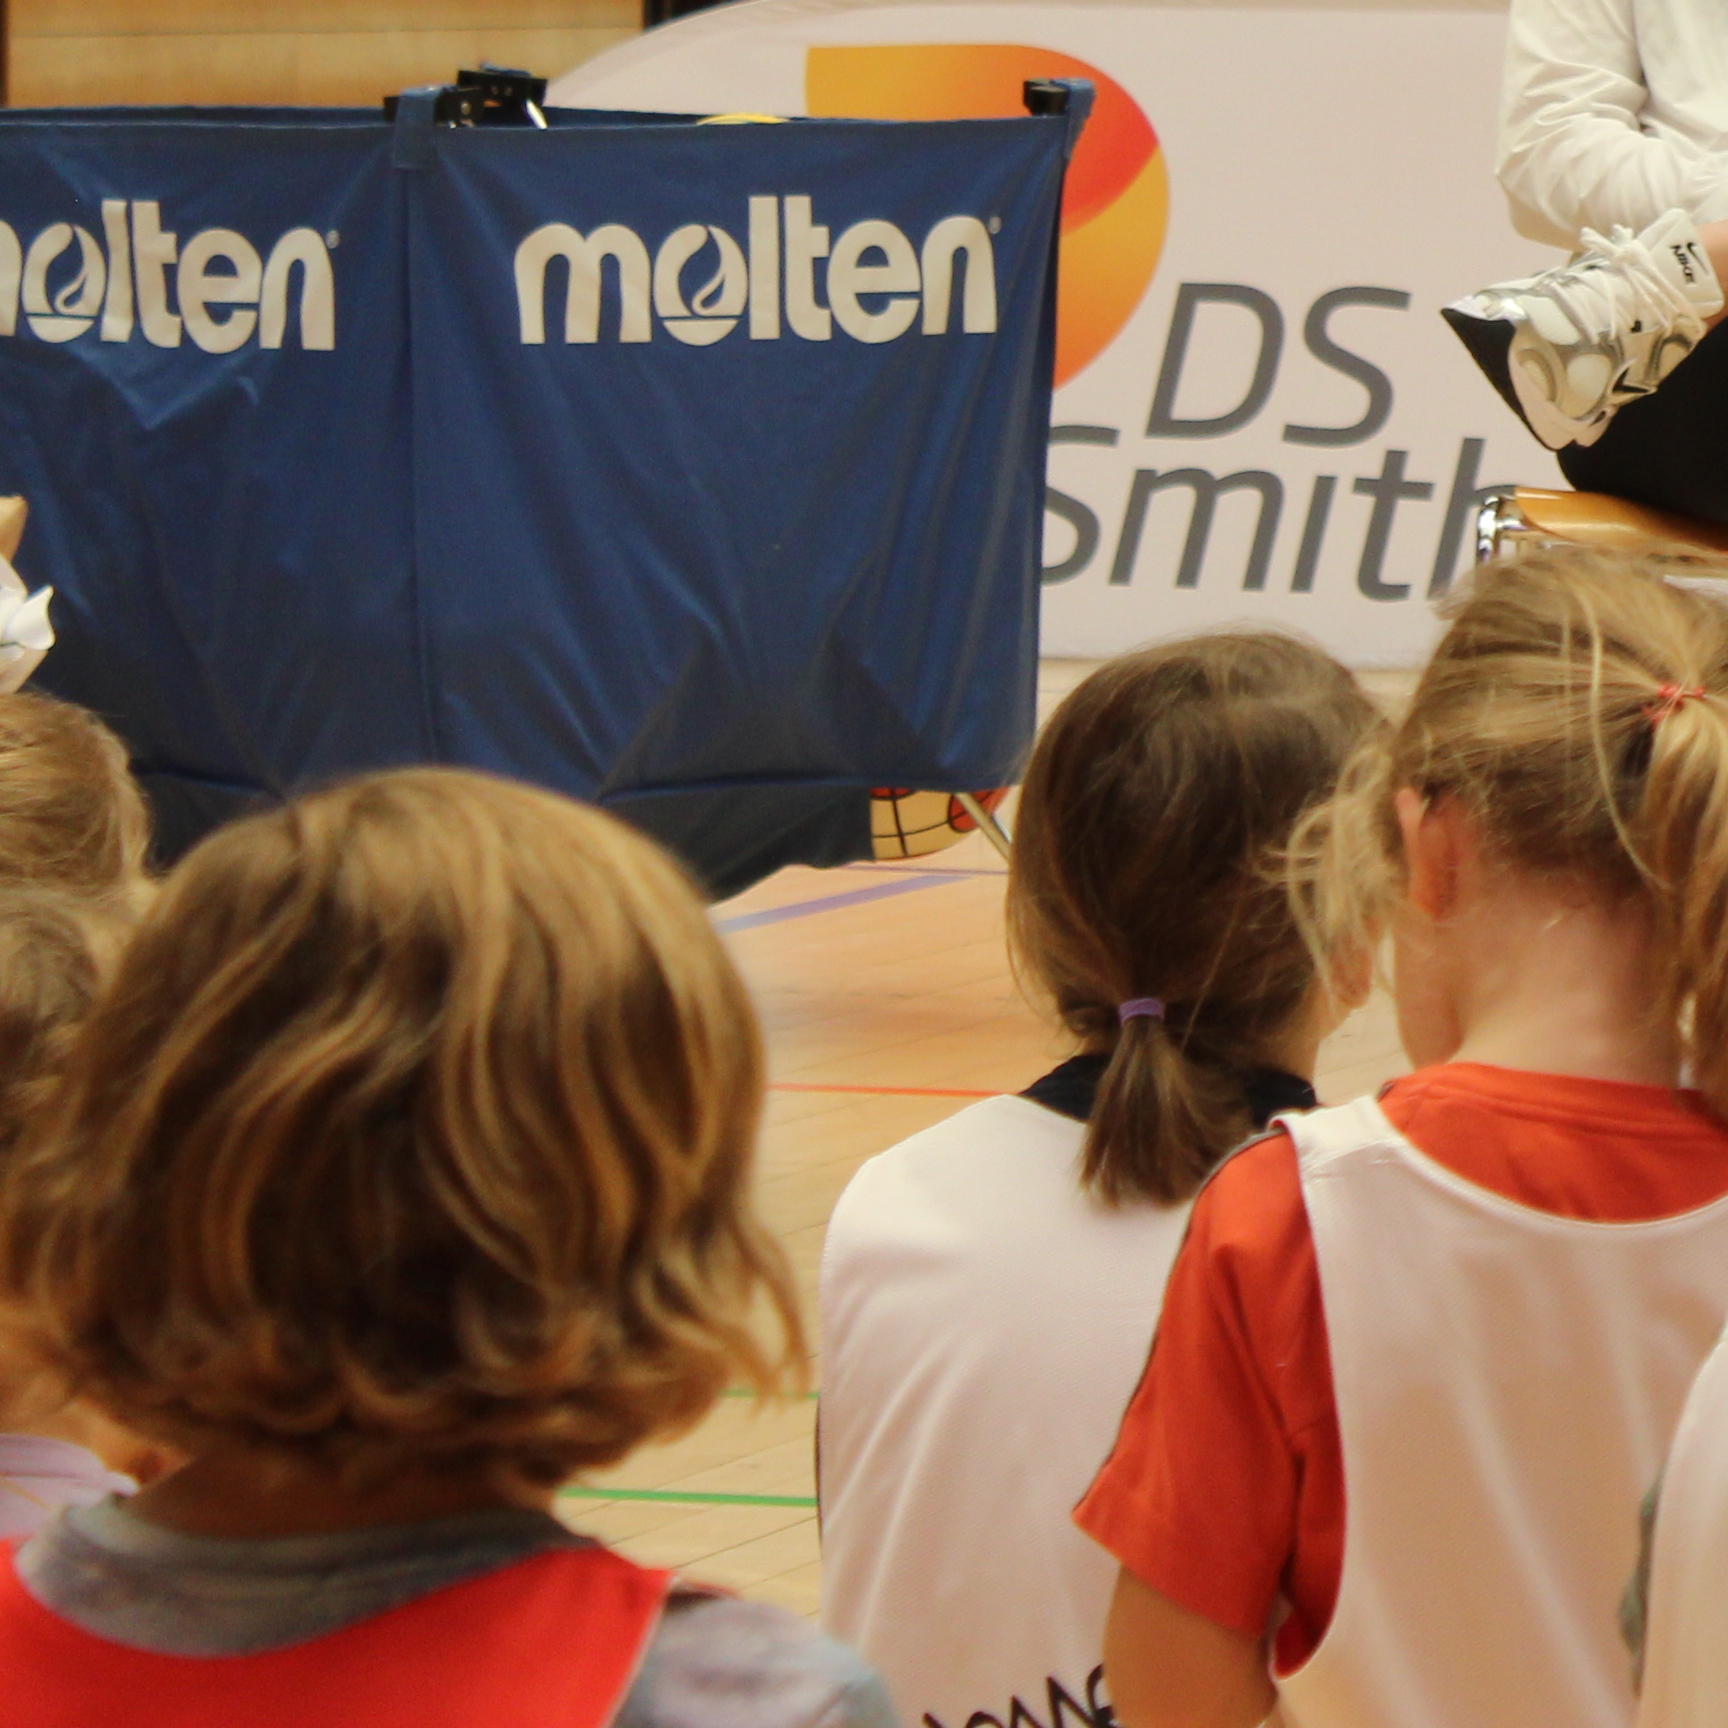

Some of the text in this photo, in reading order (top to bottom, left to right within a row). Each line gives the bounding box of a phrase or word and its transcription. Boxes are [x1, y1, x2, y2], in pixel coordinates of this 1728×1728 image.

[0, 199, 336, 355] olten
[514, 194, 998, 347] molten
[1144, 281, 1410, 450] DS
